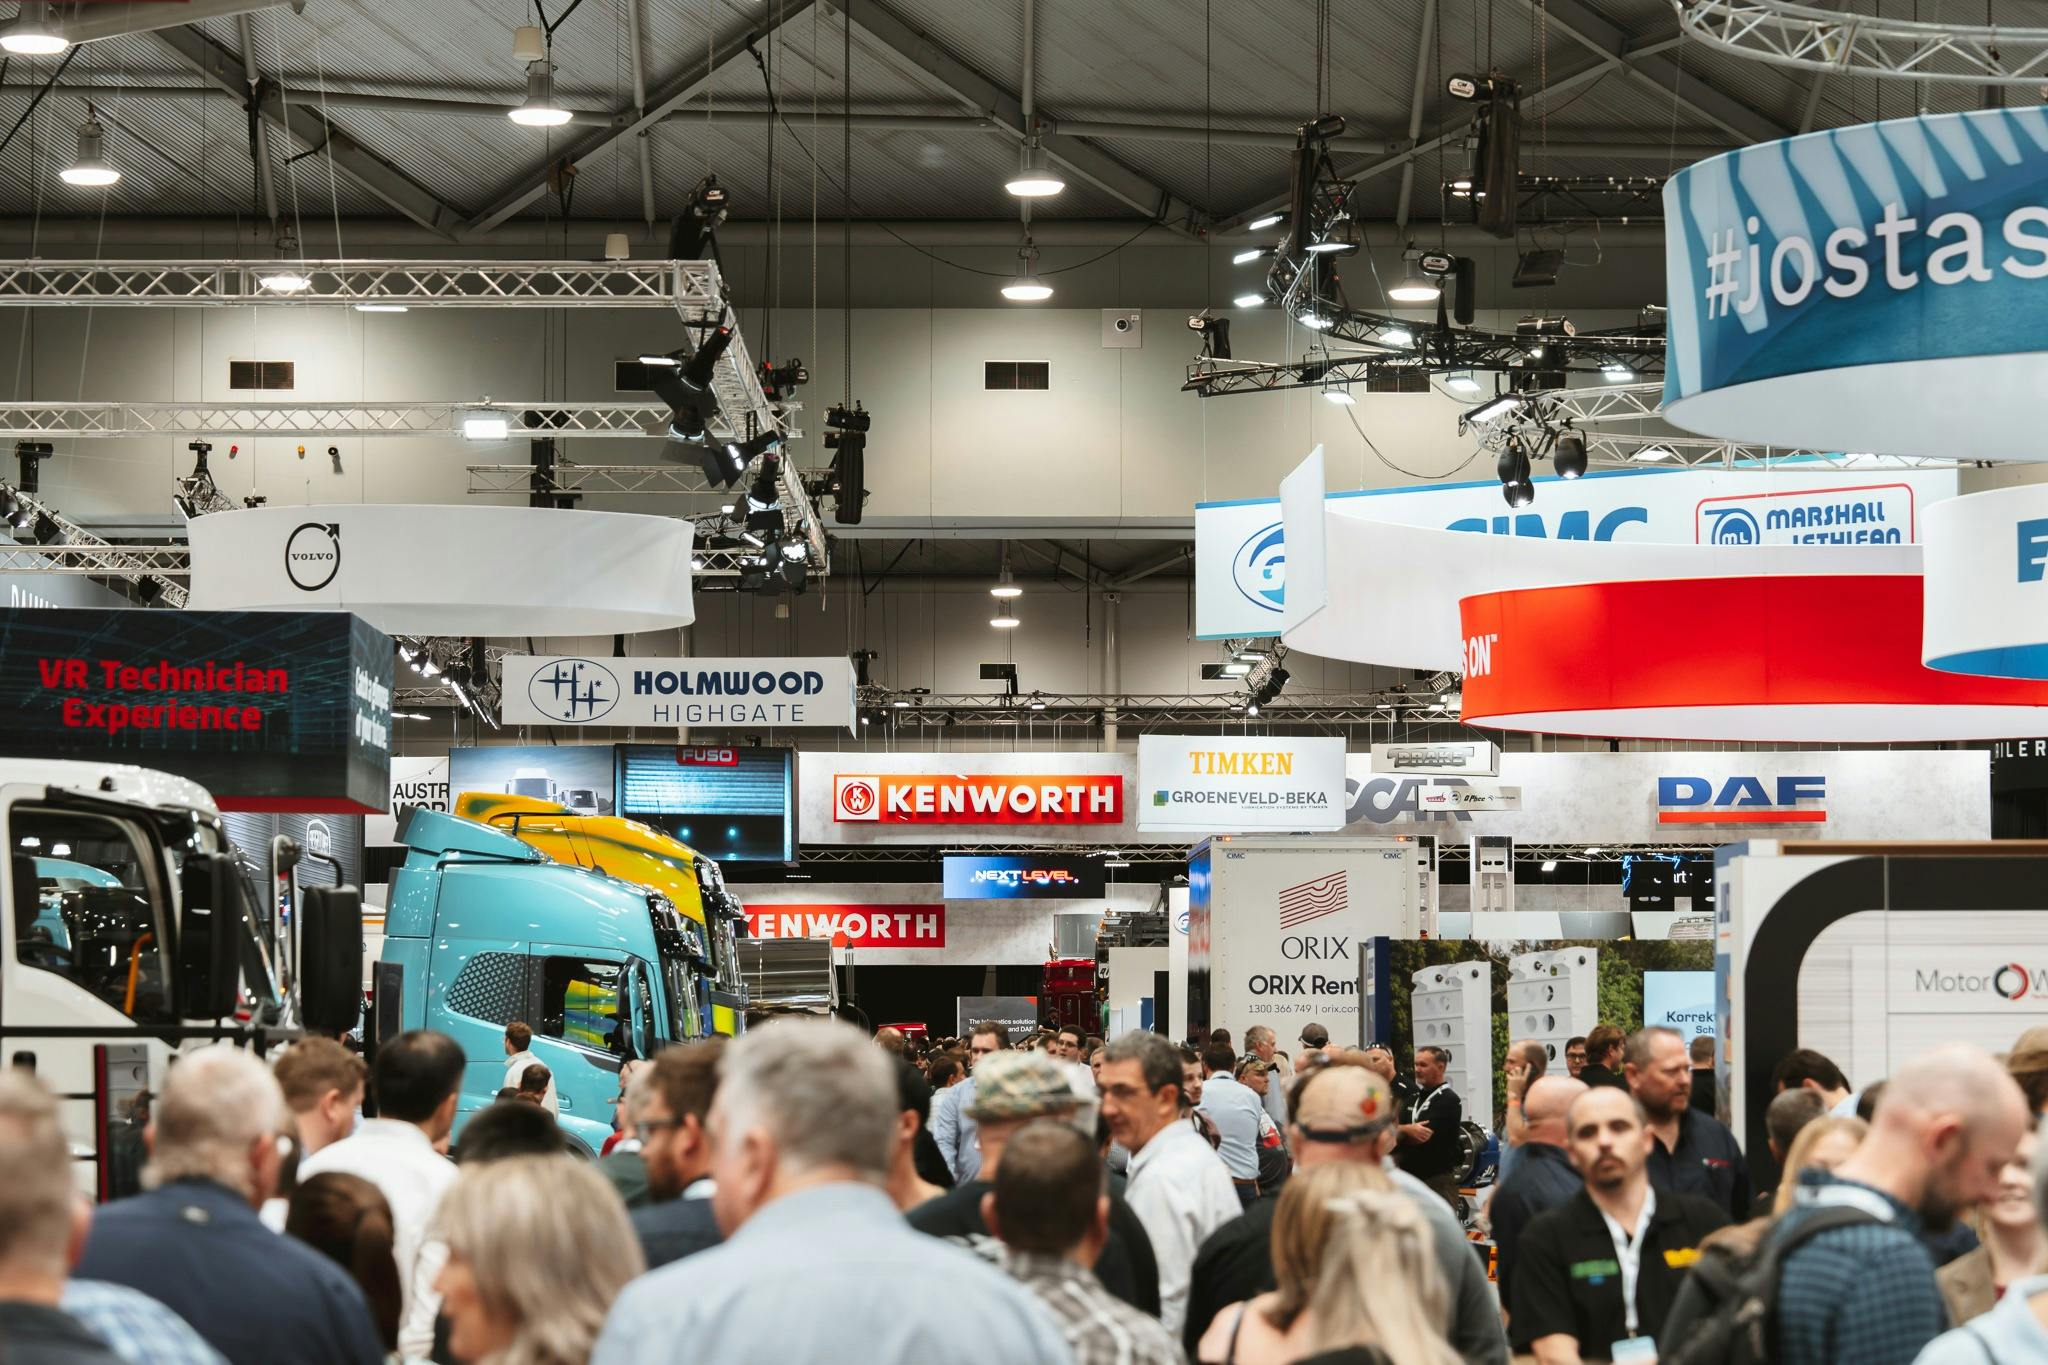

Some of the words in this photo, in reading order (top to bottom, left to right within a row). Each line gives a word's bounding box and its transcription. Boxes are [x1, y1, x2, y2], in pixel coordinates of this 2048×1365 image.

[1766, 502, 1886, 530] MARSHALL
[291, 552, 334, 561] VOLVO
[38, 658, 89, 690] VR
[99, 660, 289, 693] Technician
[633, 671, 824, 695] HOLMWOOD
[61, 697, 263, 736] Experience
[653, 704, 805, 723] HIGHGATE
[683, 749, 733, 763] FUSO
[1189, 751, 1294, 775] TIMKEN
[887, 784, 1114, 814] KENWORTH
[1172, 790, 1328, 805] GROENEVELD-BEKA
[1658, 776, 1826, 806] DAF
[1226, 852, 1246, 860] CIMC
[1383, 852, 1403, 860] CIMC
[975, 869, 1022, 881] NEXT
[1281, 936, 1350, 960] ORIX
[1248, 974, 1307, 995] ORIX
[1915, 969, 1991, 993] Motor
[1248, 1004, 1273, 1014] 1300
[1274, 1004, 1292, 1014] 366
[1294, 1004, 1312, 1014] 749
[1666, 1010, 1716, 1022] Korrek
